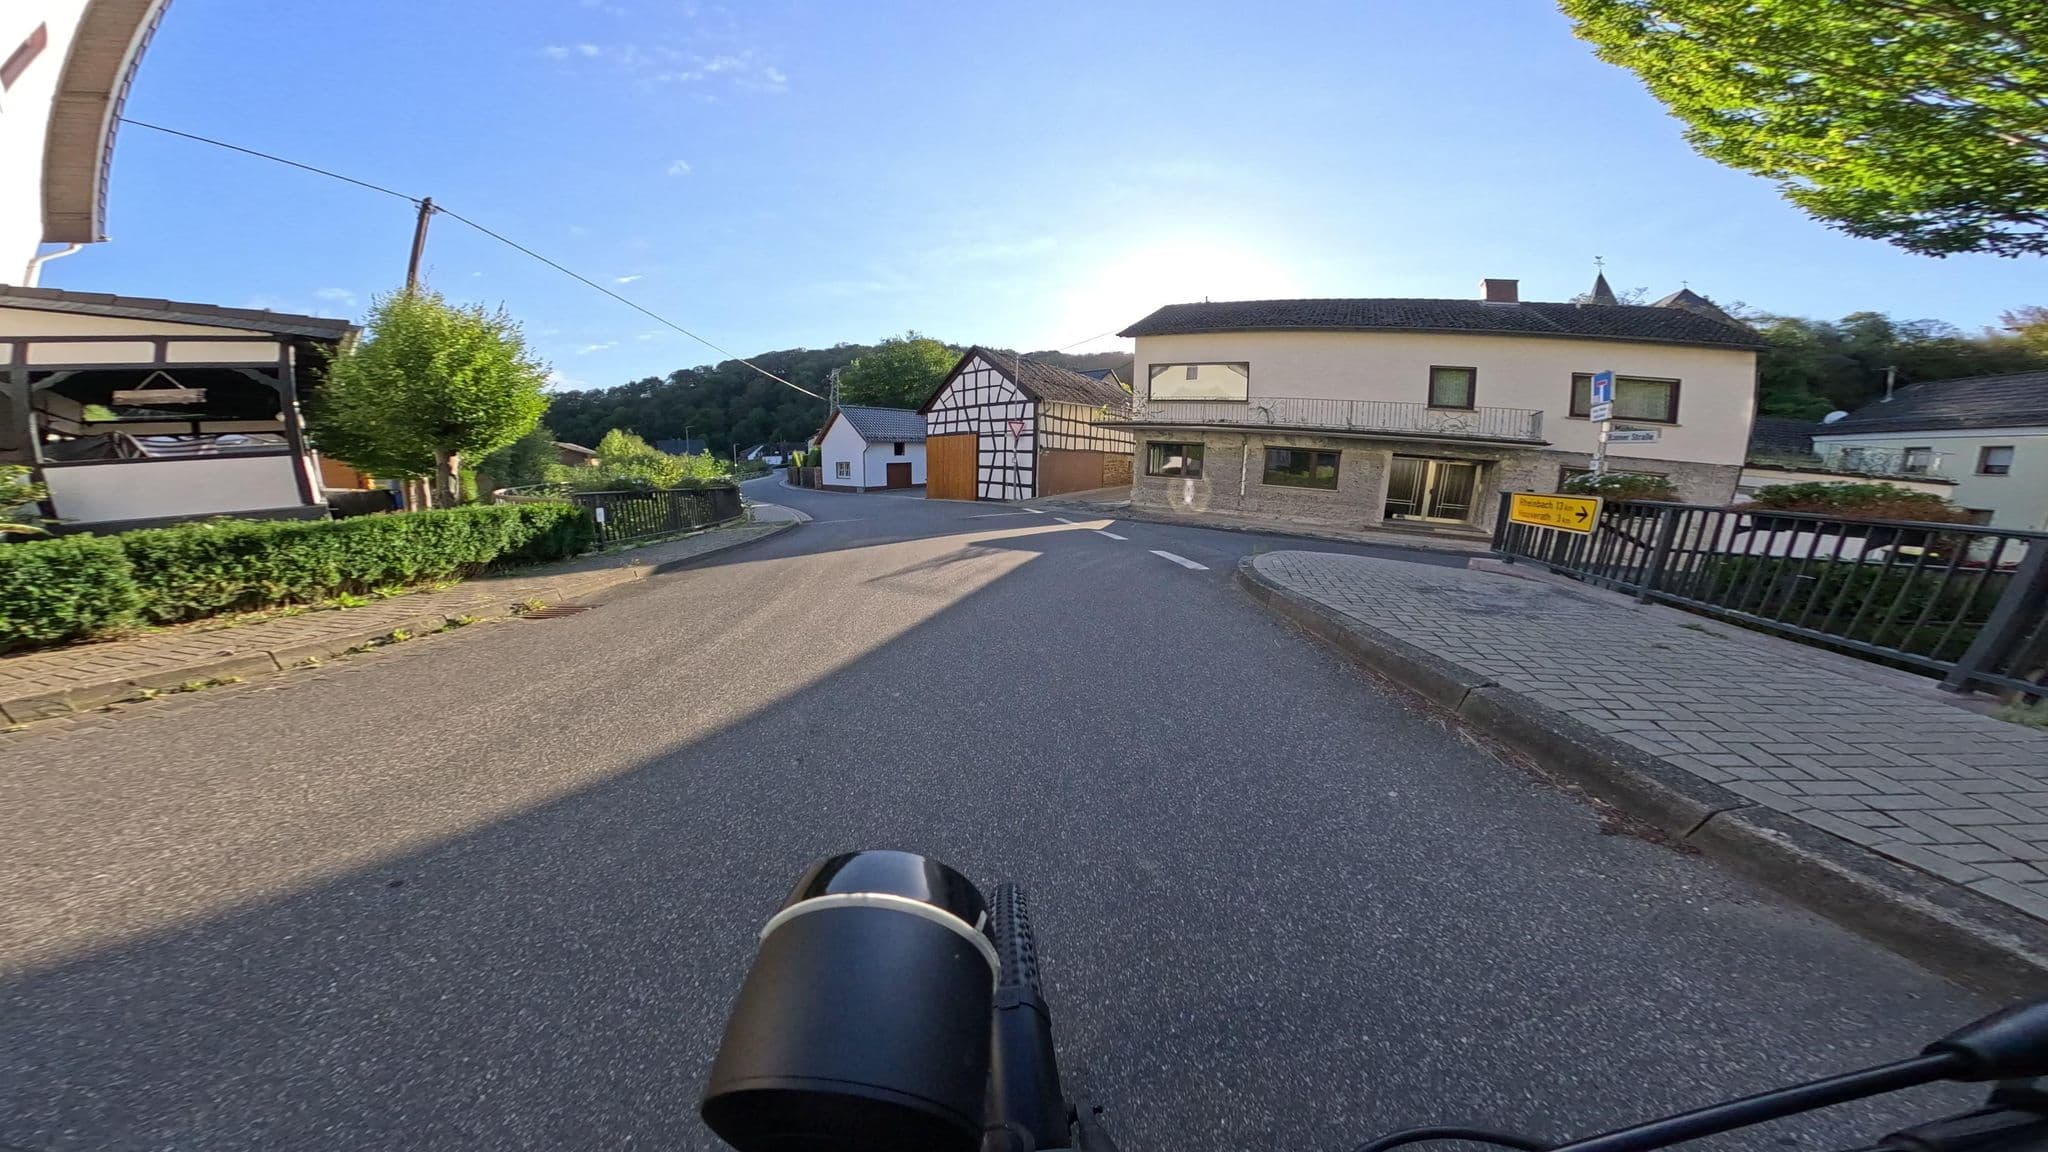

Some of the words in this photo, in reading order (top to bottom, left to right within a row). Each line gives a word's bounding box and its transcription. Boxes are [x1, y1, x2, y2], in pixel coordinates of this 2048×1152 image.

[1631, 433, 1654, 441] Straße
[1520, 498, 1553, 510] Rheinbach
[1556, 501, 1564, 511] 13
